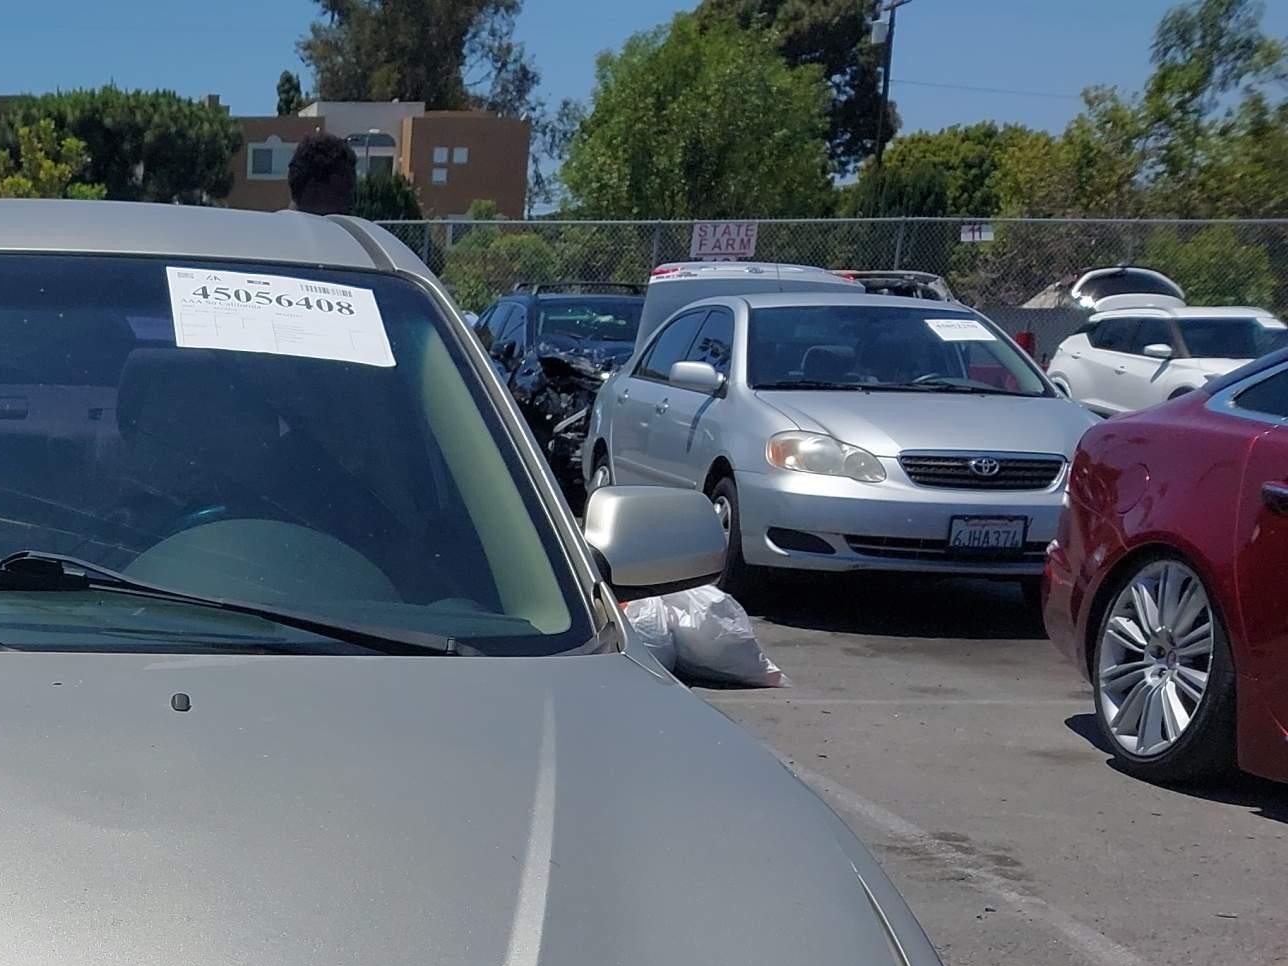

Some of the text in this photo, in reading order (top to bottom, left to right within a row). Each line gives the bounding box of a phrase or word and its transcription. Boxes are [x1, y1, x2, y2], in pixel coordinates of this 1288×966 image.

[698, 224, 754, 238] STATE
[969, 226, 982, 240] 11
[698, 239, 752, 251] FARM
[192, 285, 355, 316] 45056408
[953, 529, 1018, 548] 6JHA374
